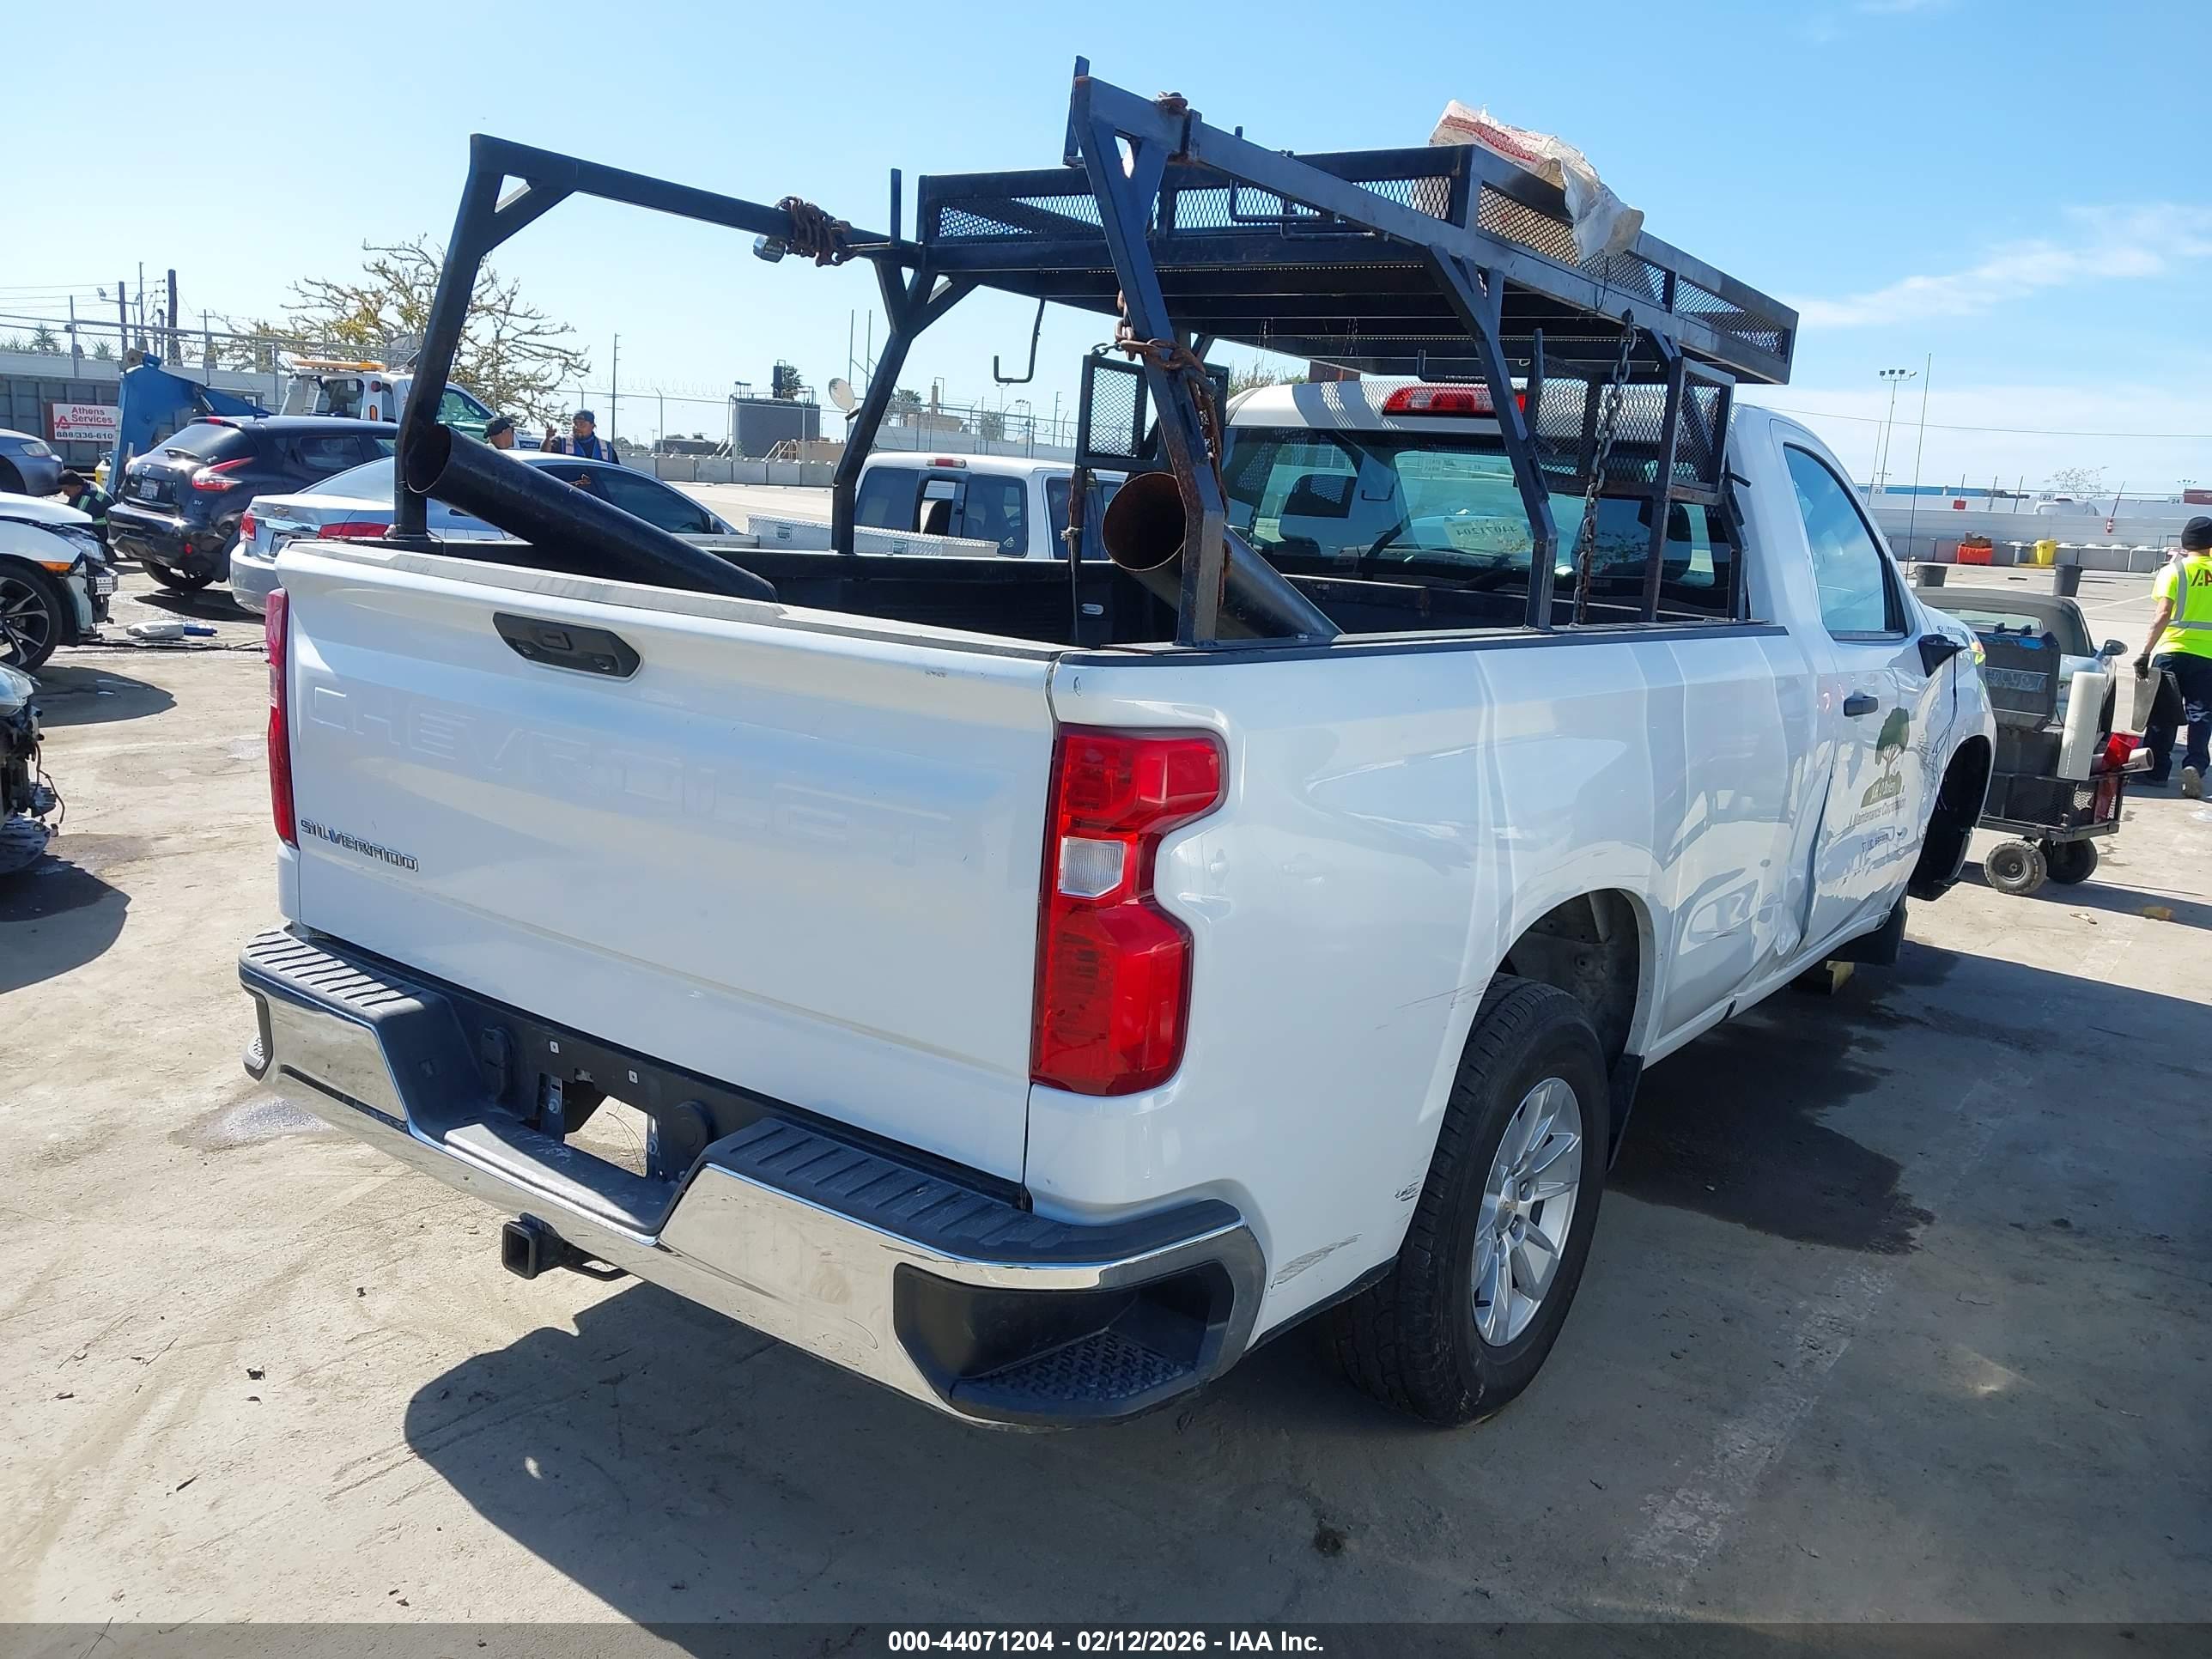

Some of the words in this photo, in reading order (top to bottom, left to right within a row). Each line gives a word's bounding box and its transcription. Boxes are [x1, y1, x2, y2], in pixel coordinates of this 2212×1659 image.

[71, 406, 105, 416] Athens
[71, 414, 112, 423] Services
[307, 684, 955, 867] CHEVROLET
[301, 818, 419, 872] SILVERADO
